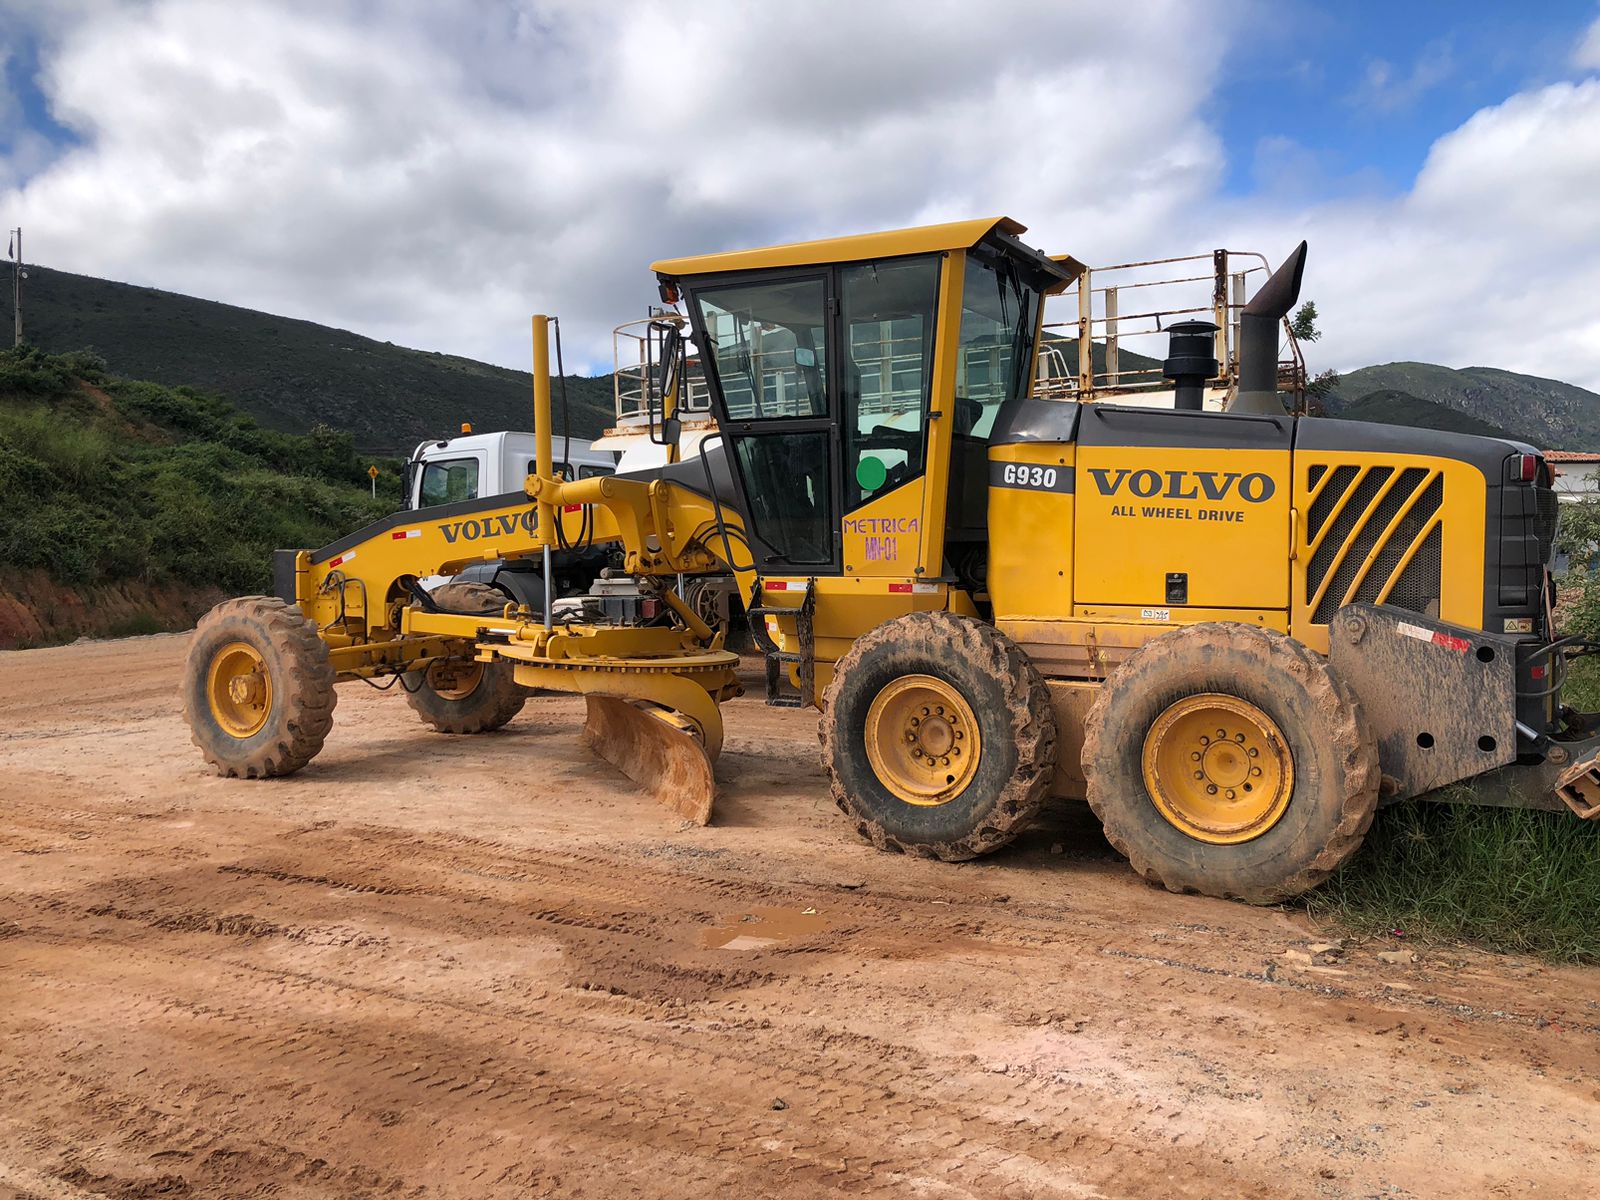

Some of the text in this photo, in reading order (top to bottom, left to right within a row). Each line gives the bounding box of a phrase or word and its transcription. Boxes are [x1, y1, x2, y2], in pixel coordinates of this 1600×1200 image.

[1003, 464, 1057, 488] G930
[1087, 468, 1276, 503] VOLVO
[843, 518, 919, 534] METRICA
[1111, 505, 1245, 523] ALL WHEEL DRIVE
[439, 511, 538, 543] VOLVO
